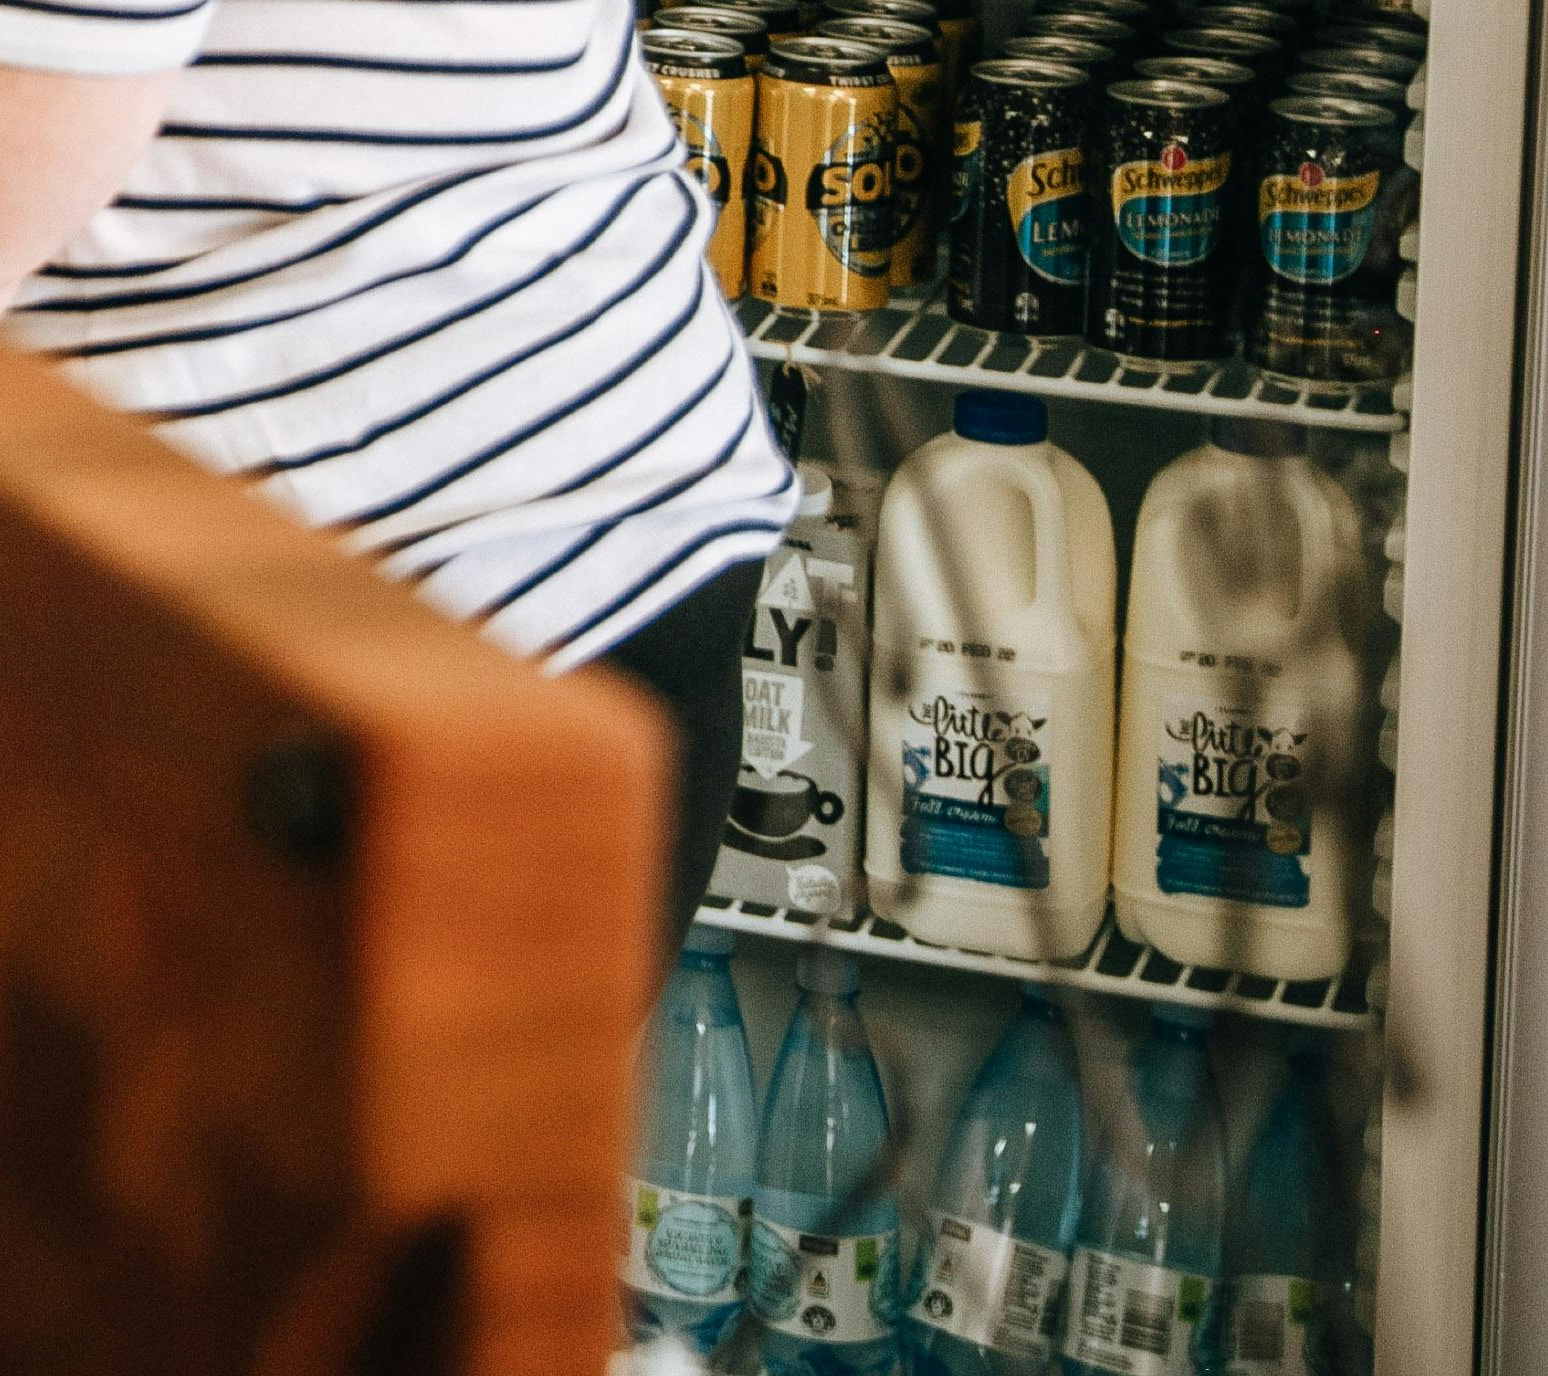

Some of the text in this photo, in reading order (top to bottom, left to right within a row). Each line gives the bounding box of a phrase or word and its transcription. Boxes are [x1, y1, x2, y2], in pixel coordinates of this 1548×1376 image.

[1122, 162, 1227, 194] Schweppes
[1125, 205, 1220, 229] LEMONADE
[745, 677, 785, 707] OAT
[743, 703, 792, 735] MILK
